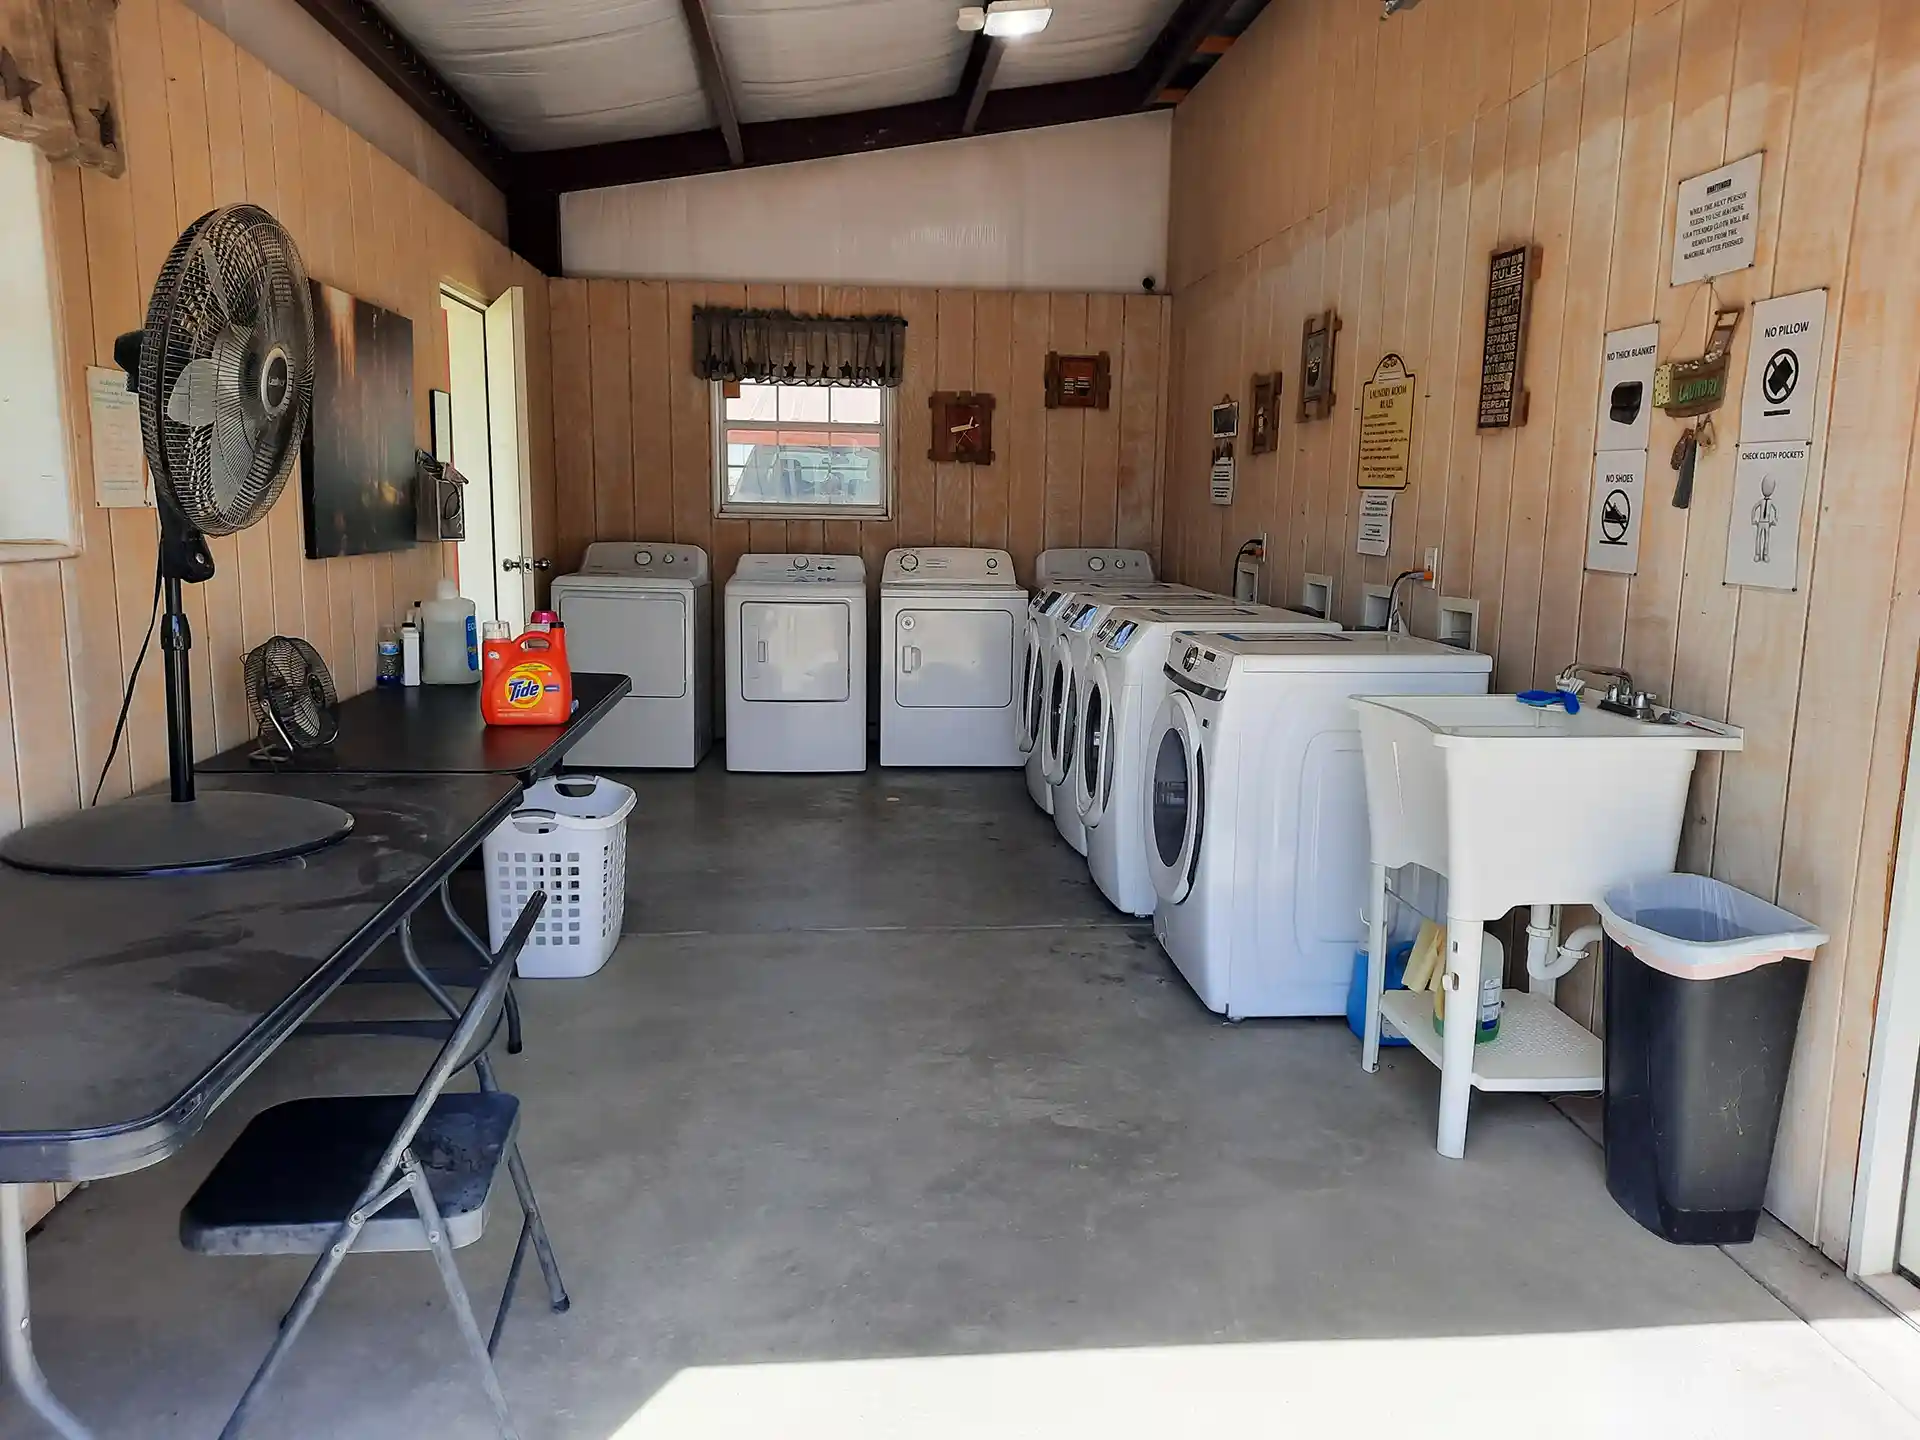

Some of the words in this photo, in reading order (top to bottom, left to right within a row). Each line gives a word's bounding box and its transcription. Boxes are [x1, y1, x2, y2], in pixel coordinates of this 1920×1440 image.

[1713, 198, 1726, 208] NEXT
[1727, 191, 1747, 203] PERSON
[1722, 203, 1744, 216] MACHINE
[1730, 216, 1741, 224] WILL
[1742, 213, 1750, 221] BE
[1714, 231, 1727, 240] FROM
[1728, 228, 1737, 236] THE
[1706, 244, 1721, 254] AFTER
[1492, 264, 1522, 280] RULES
[1764, 325, 1777, 338] NO
[1778, 321, 1809, 336] PILLOW
[1606, 351, 1616, 361] NO
[1616, 348, 1631, 359] THICK
[1631, 345, 1656, 357] BLANKET
[1481, 399, 1510, 409] REPEAT
[1742, 452, 1758, 460] CHECK
[1759, 451, 1777, 460] CLOTH
[1778, 450, 1804, 460] POCKETS
[1605, 474, 1615, 483] NO
[1615, 474, 1633, 483] SHOES
[508, 679, 540, 702] Tide
